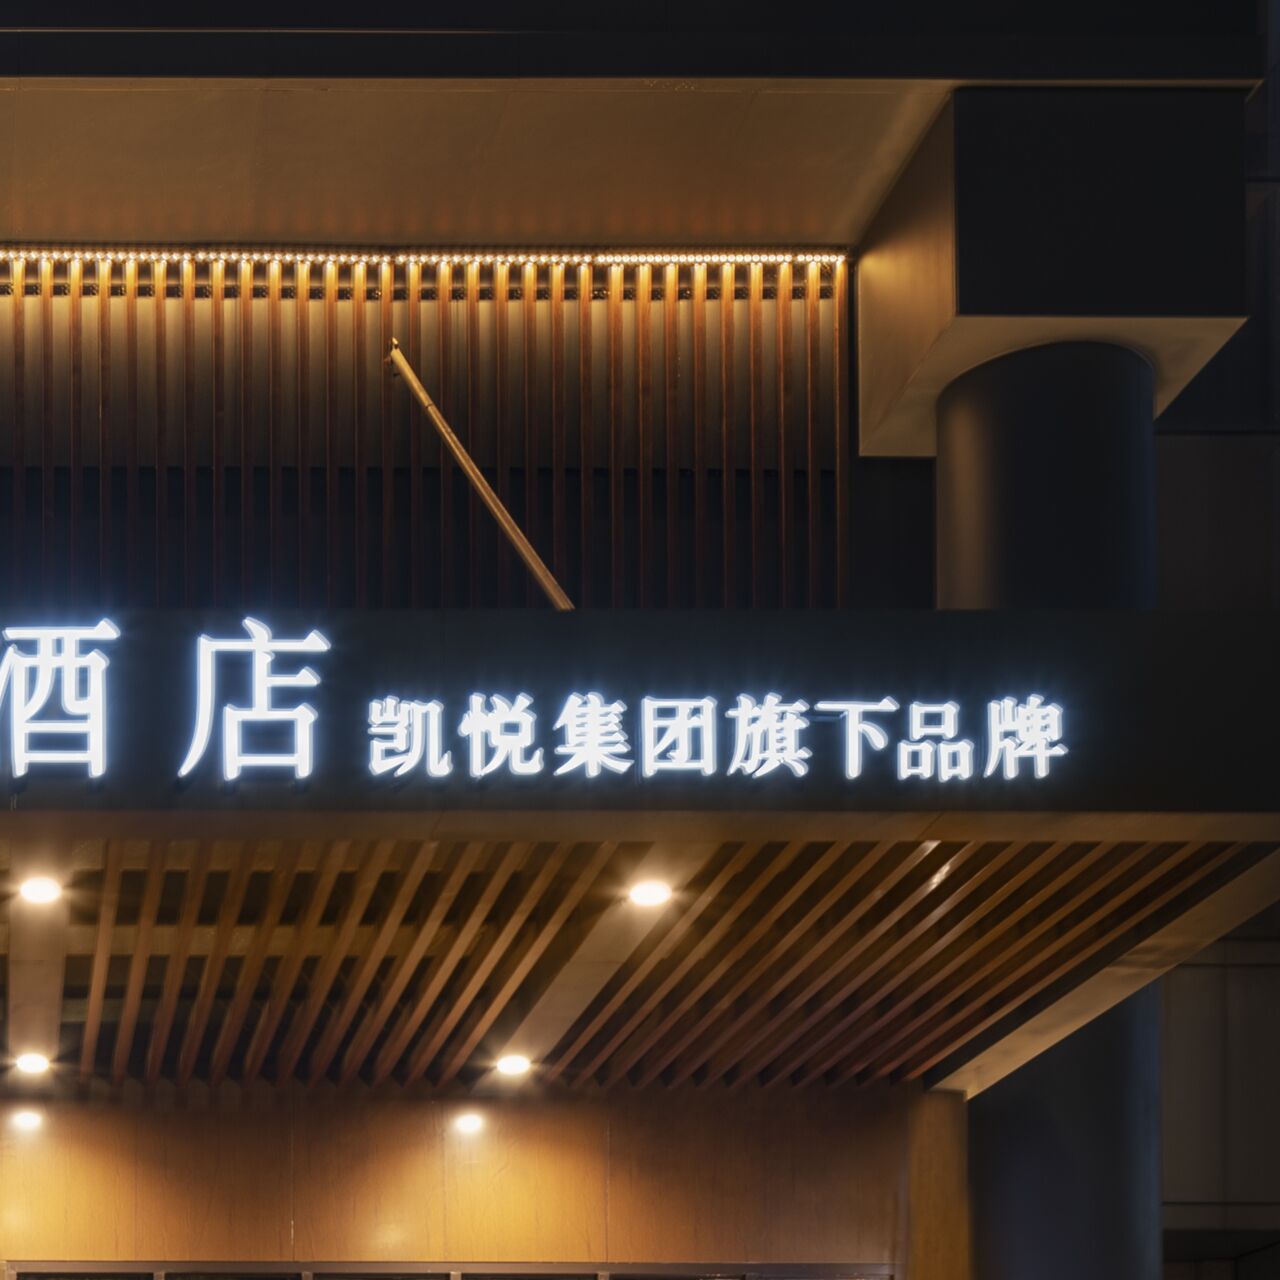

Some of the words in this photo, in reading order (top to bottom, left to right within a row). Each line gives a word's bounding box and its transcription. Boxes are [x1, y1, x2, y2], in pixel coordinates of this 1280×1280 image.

[367, 691, 1069, 783] 凯悦集团旗下品牌
